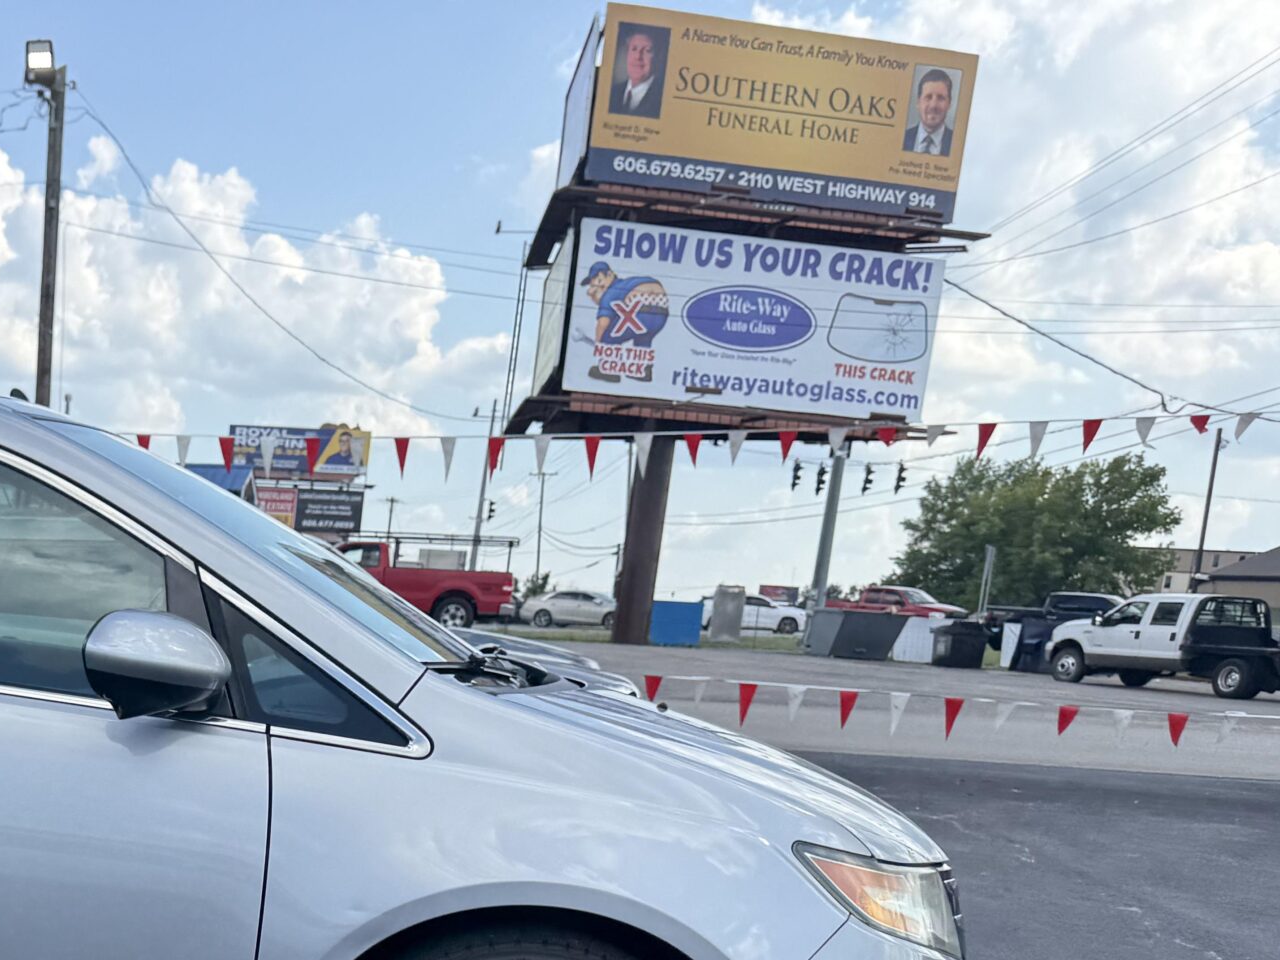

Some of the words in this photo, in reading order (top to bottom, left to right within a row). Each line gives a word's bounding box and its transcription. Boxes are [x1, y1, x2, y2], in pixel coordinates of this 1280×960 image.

[682, 28, 690, 40] A
[692, 30, 727, 46] Name
[728, 35, 748, 48] You
[750, 37, 773, 52] Can
[776, 40, 804, 58] Trust,
[806, 45, 815, 58] A
[816, 46, 854, 66] Family
[854, 52, 874, 68] You
[876, 55, 910, 72] Know
[676, 66, 820, 108] SOUTHERN
[829, 87, 897, 120] OAKS
[706, 107, 794, 136] FUNERAL
[800, 119, 860, 145] HOME
[613, 156, 725, 183] 606.679.6257
[738, 170, 773, 190] 2110
[777, 176, 824, 195] WEST
[828, 182, 907, 205] HIGHWAY
[908, 190, 936, 209] 914
[594, 225, 688, 264] SHOW
[694, 238, 734, 269] US
[742, 242, 822, 278] YOUR
[828, 251, 934, 294] CRACK!
[718, 294, 792, 322] Rite-Way
[723, 320, 748, 334] Auto
[749, 322, 776, 336] Glass
[593, 345, 622, 358] NOT
[625, 348, 655, 362] THIS
[602, 360, 644, 376] CRACK
[671, 366, 920, 410] ritewayautoglass.com
[834, 363, 867, 378] THIS
[870, 366, 916, 384] CRACK
[235, 426, 288, 438] ROYAL
